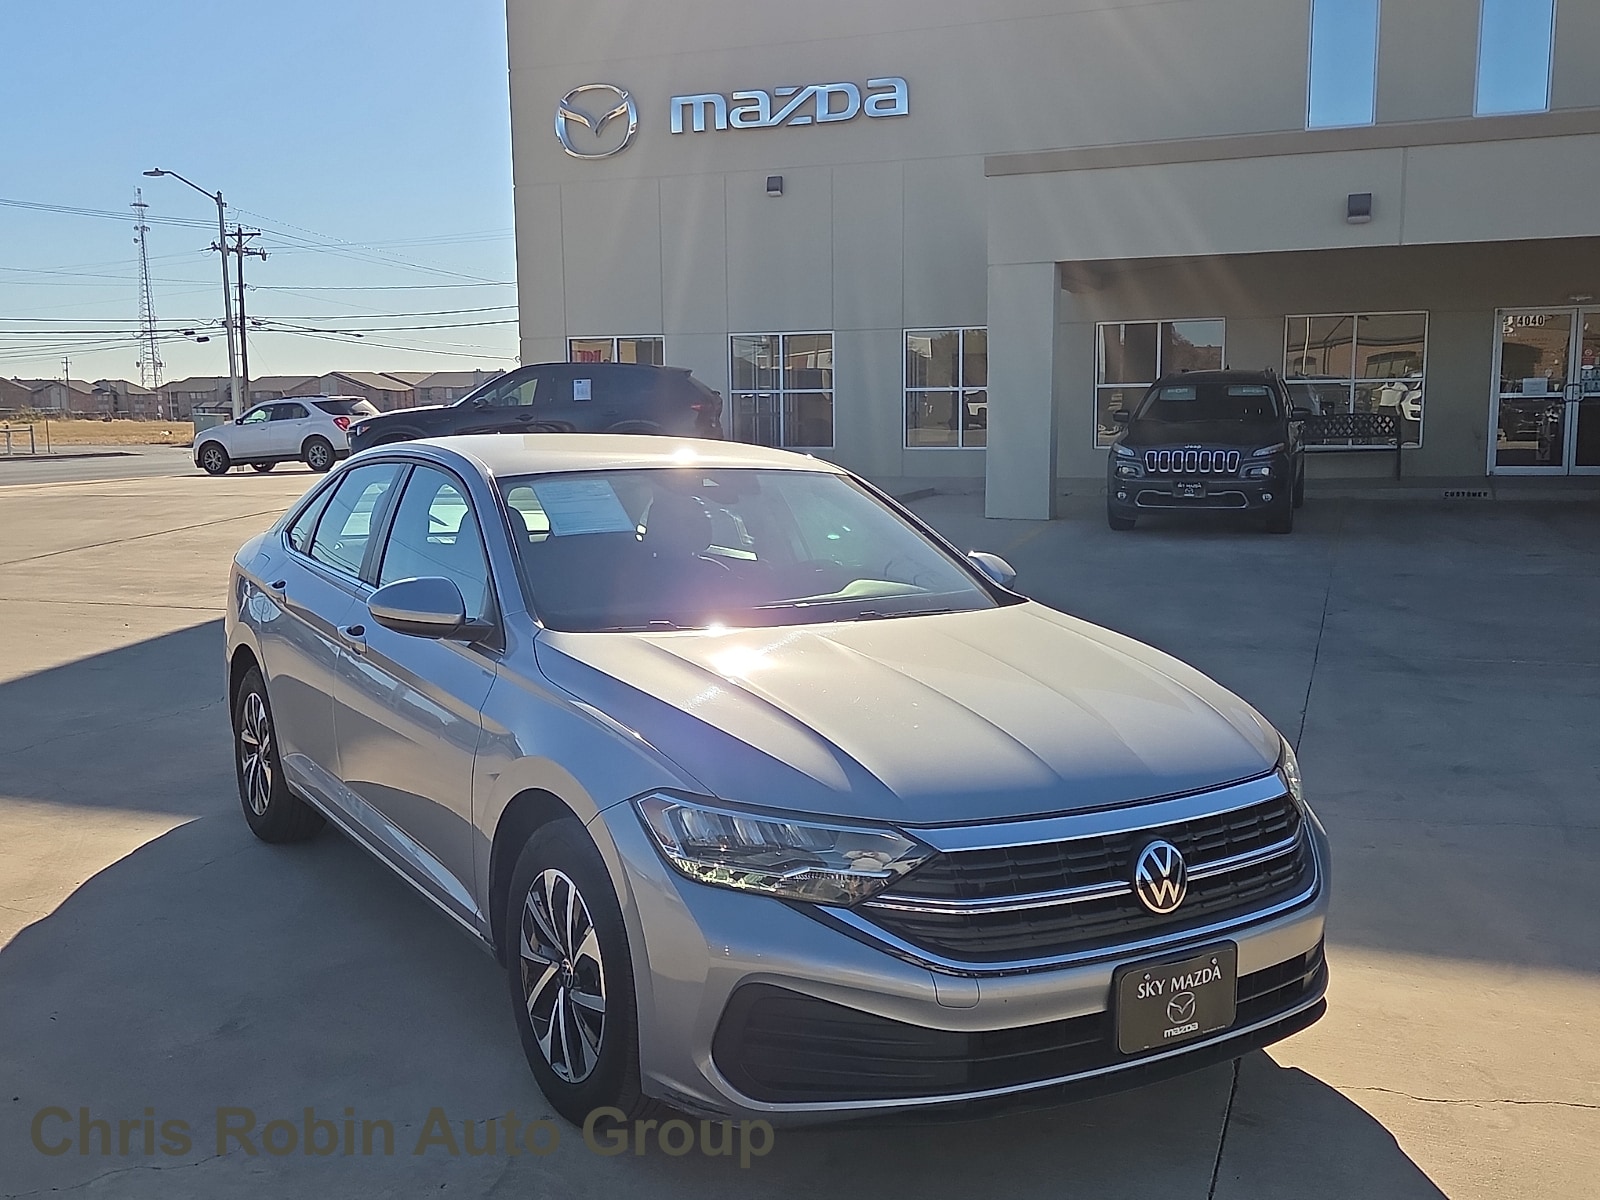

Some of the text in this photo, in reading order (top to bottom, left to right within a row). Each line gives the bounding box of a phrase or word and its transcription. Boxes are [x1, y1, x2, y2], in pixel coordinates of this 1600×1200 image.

[1517, 315, 1545, 327] 4040
[1137, 965, 1222, 999] SKY MAZDA
